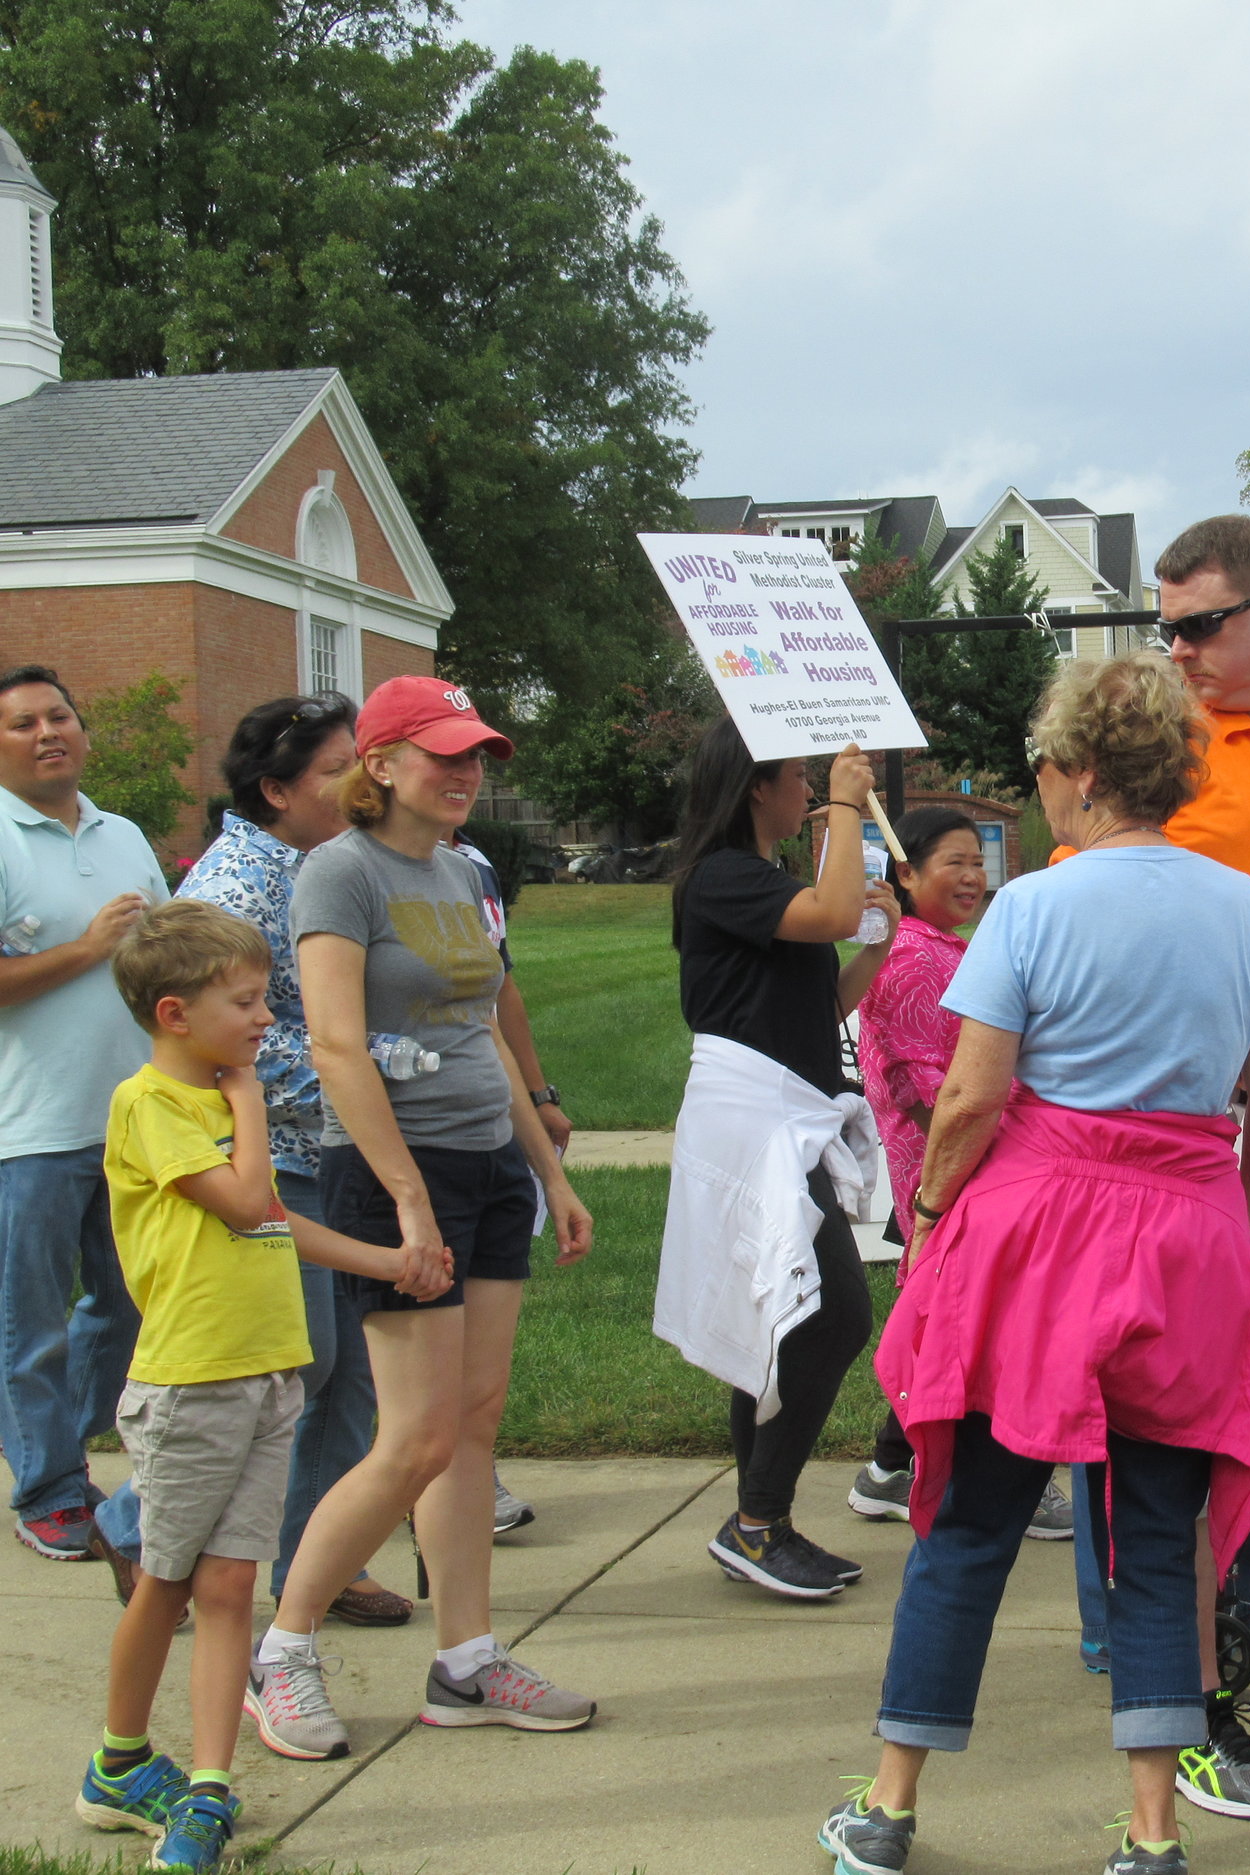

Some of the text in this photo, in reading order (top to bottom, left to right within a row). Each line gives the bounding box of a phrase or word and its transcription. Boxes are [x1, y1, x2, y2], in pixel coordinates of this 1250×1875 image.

[664, 555, 736, 583] UNITED
[733, 550, 829, 569] Silver Spring United
[749, 573, 835, 589] Methodist Cluster
[703, 579, 721, 603] for
[688, 604, 759, 619] AFFORDABLE
[769, 600, 843, 620] Walk for
[706, 621, 758, 636] HOUSING
[780, 631, 869, 652] Affordable
[802, 661, 877, 686] Housing
[749, 696, 891, 715] Hughes-El Buen Samaritano UMC
[785, 713, 881, 728] 10700 Georgia Avenue
[852, 729, 867, 739] MD
